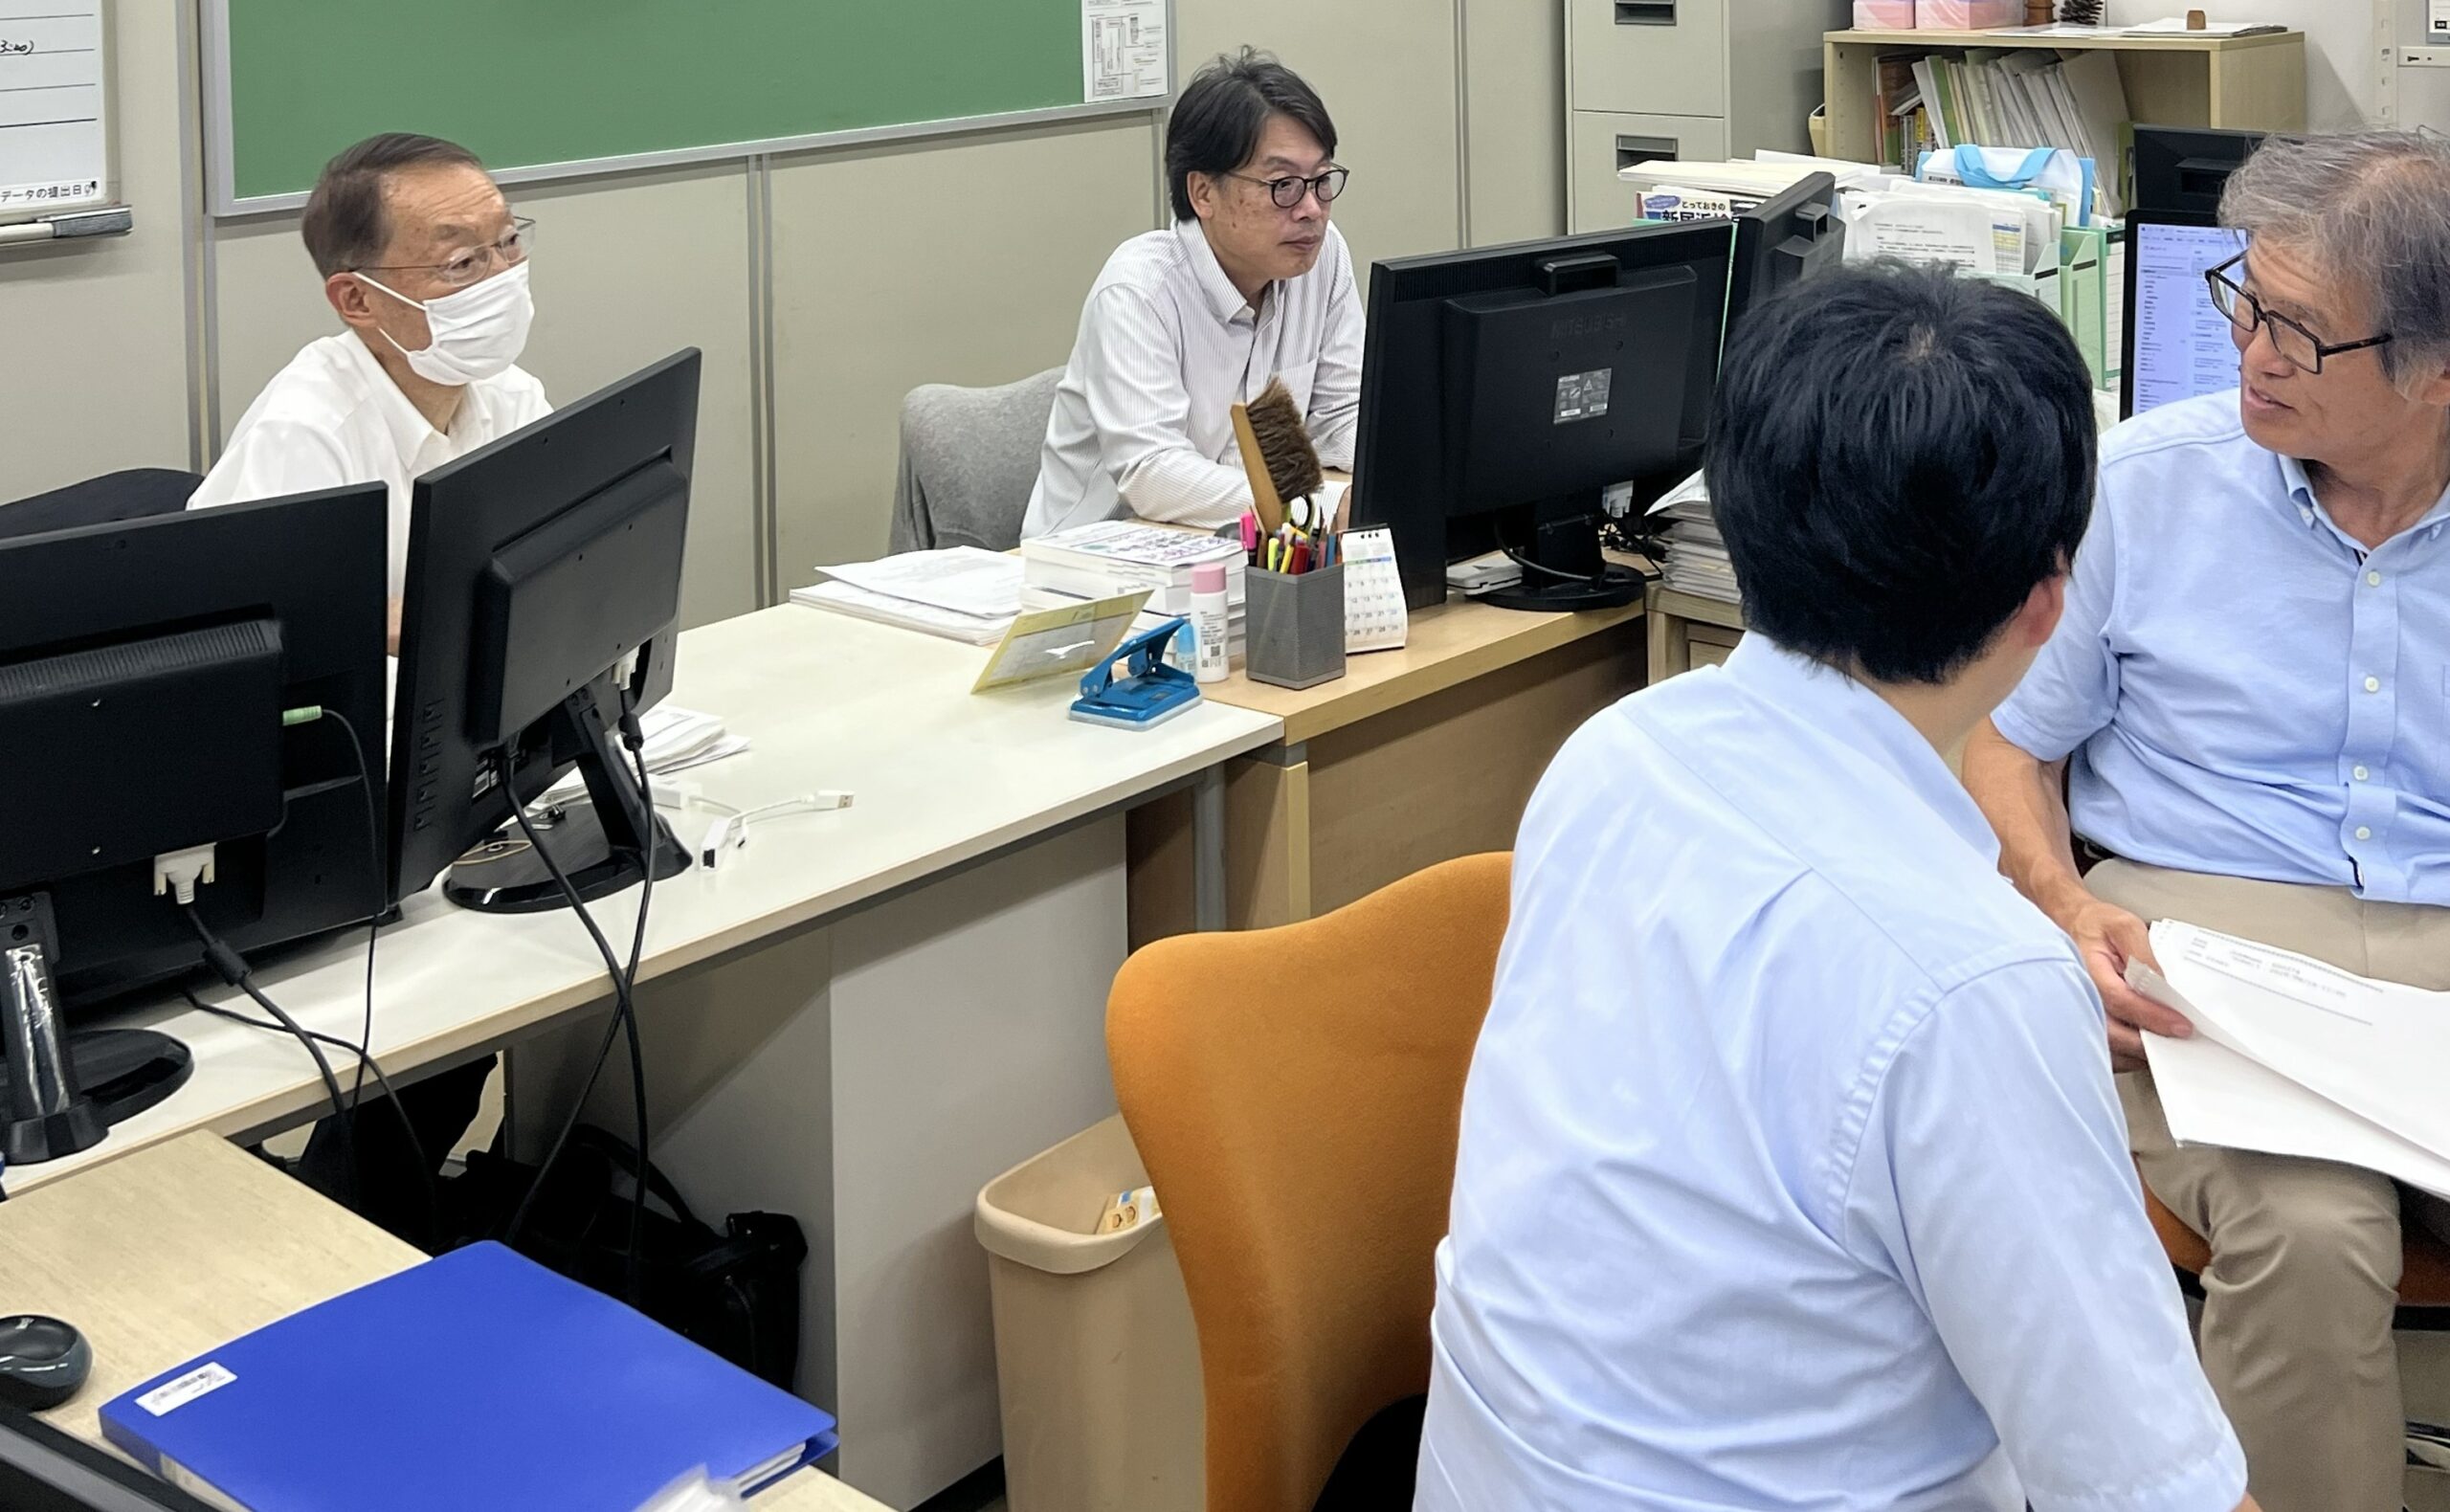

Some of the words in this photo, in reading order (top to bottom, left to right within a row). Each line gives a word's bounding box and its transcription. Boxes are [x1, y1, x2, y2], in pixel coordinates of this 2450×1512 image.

[1682, 201, 1726, 211] とっておきの
